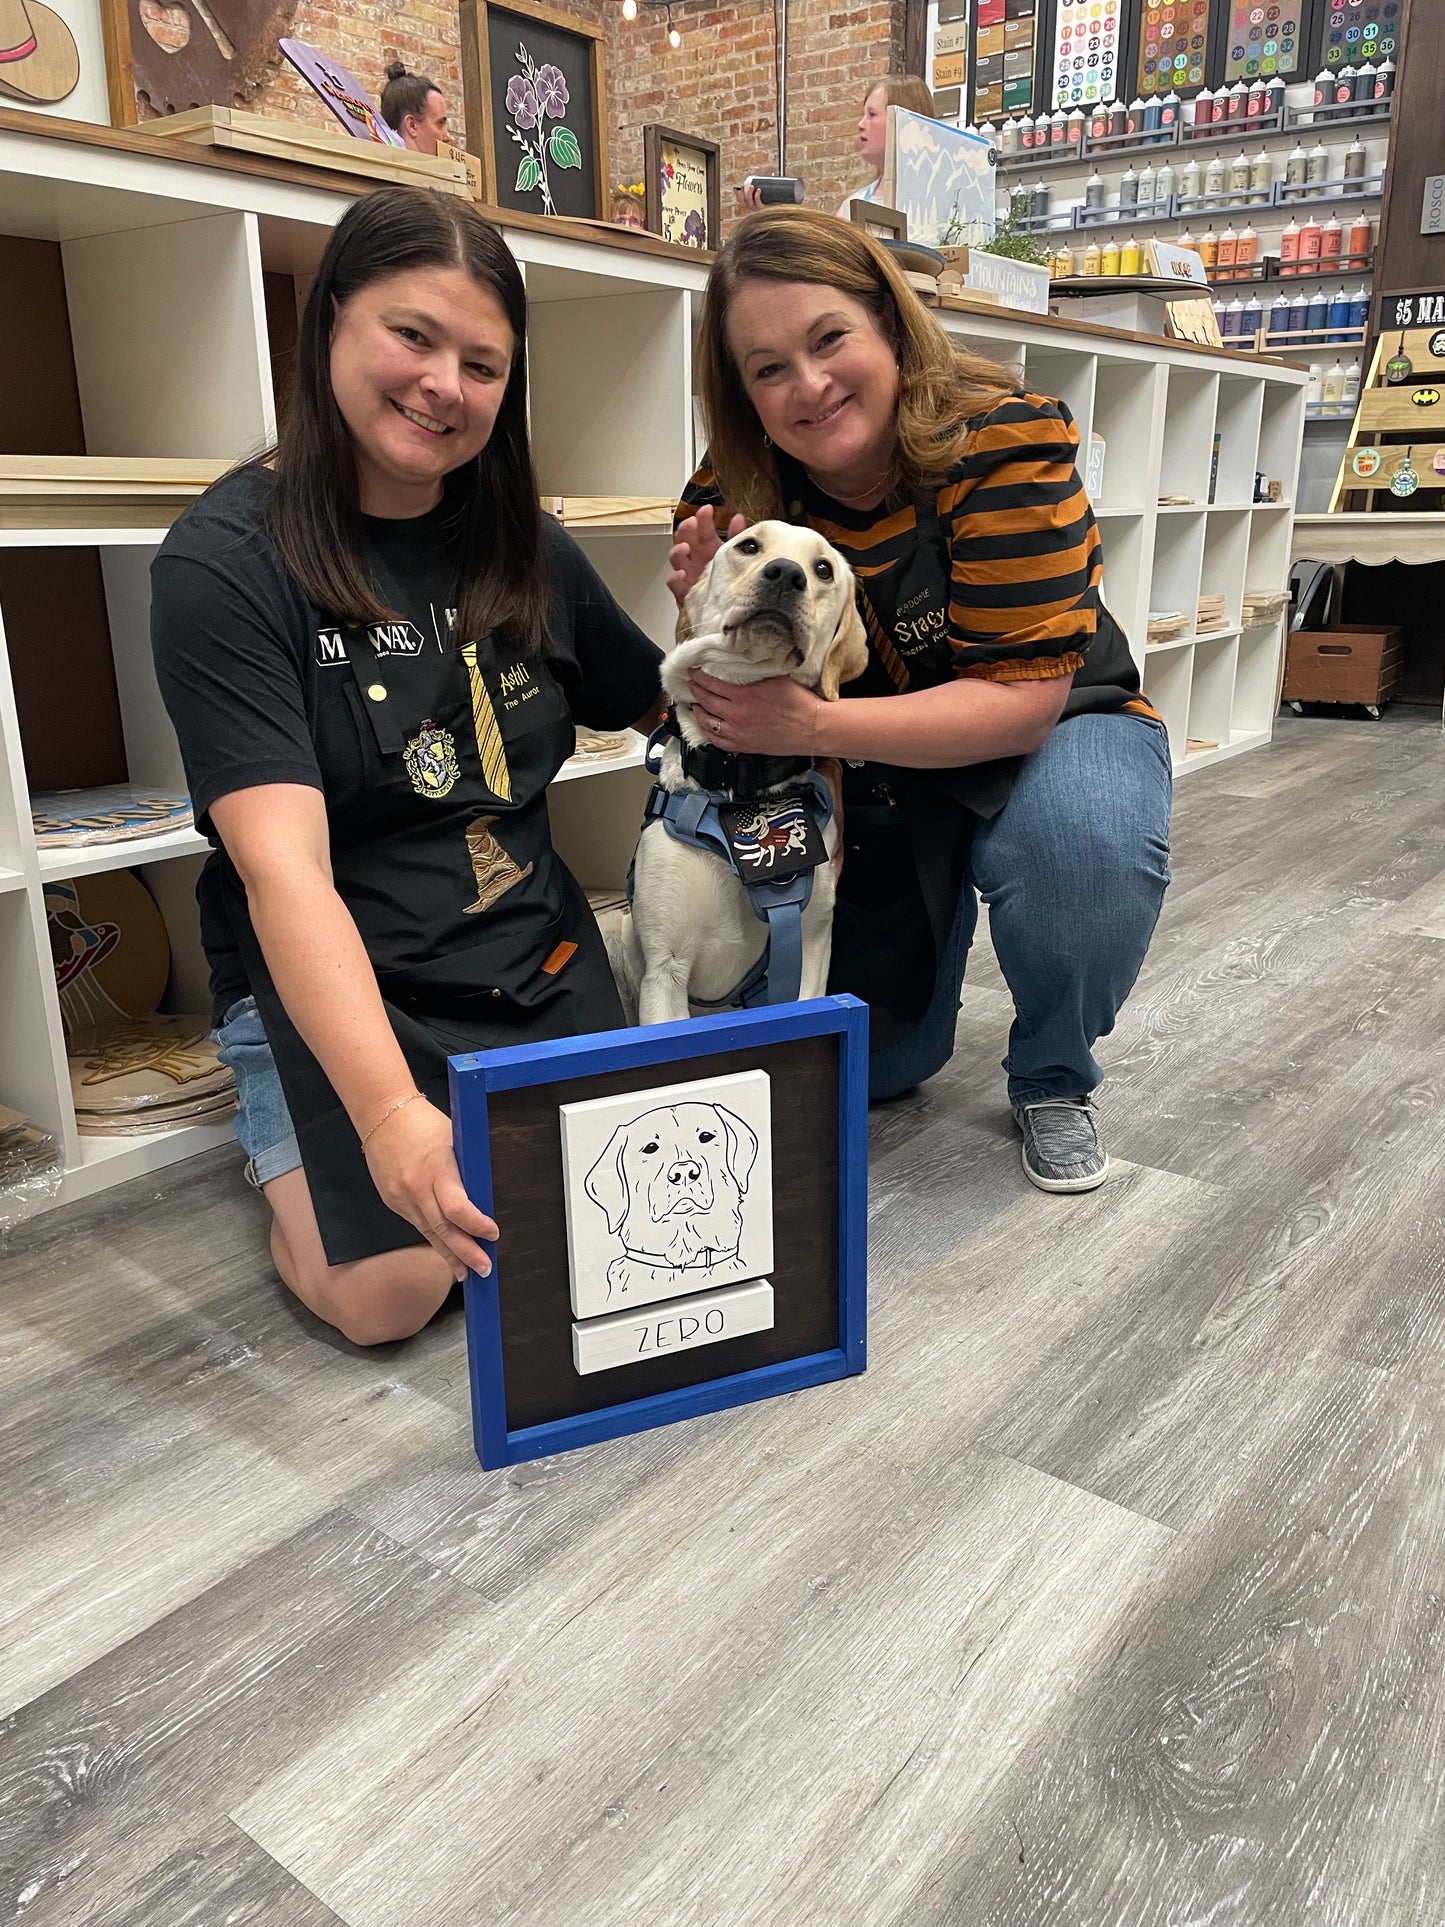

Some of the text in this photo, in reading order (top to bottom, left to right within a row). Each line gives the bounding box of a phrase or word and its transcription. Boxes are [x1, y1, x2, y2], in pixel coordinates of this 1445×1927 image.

[1332, 15, 1343, 25] 25
[1347, 30, 1359, 39] 30
[1365, 27, 1376, 37] 31
[936, 36, 964, 50] Stain #7
[1329, 49, 1340, 59] 33
[1363, 43, 1375, 54] 35
[1381, 40, 1393, 51] 36
[935, 67, 962, 80] Stain #9
[1430, 178, 1444, 229] ROSCO
[971, 262, 1037, 298] MOUNTAINS
[1395, 295, 1445, 325] $5 MA
[894, 607, 945, 643] Stacy
[500, 663, 530, 696] Ashli
[504, 686, 540, 710] The Auror
[634, 1309, 724, 1352] ZERO
